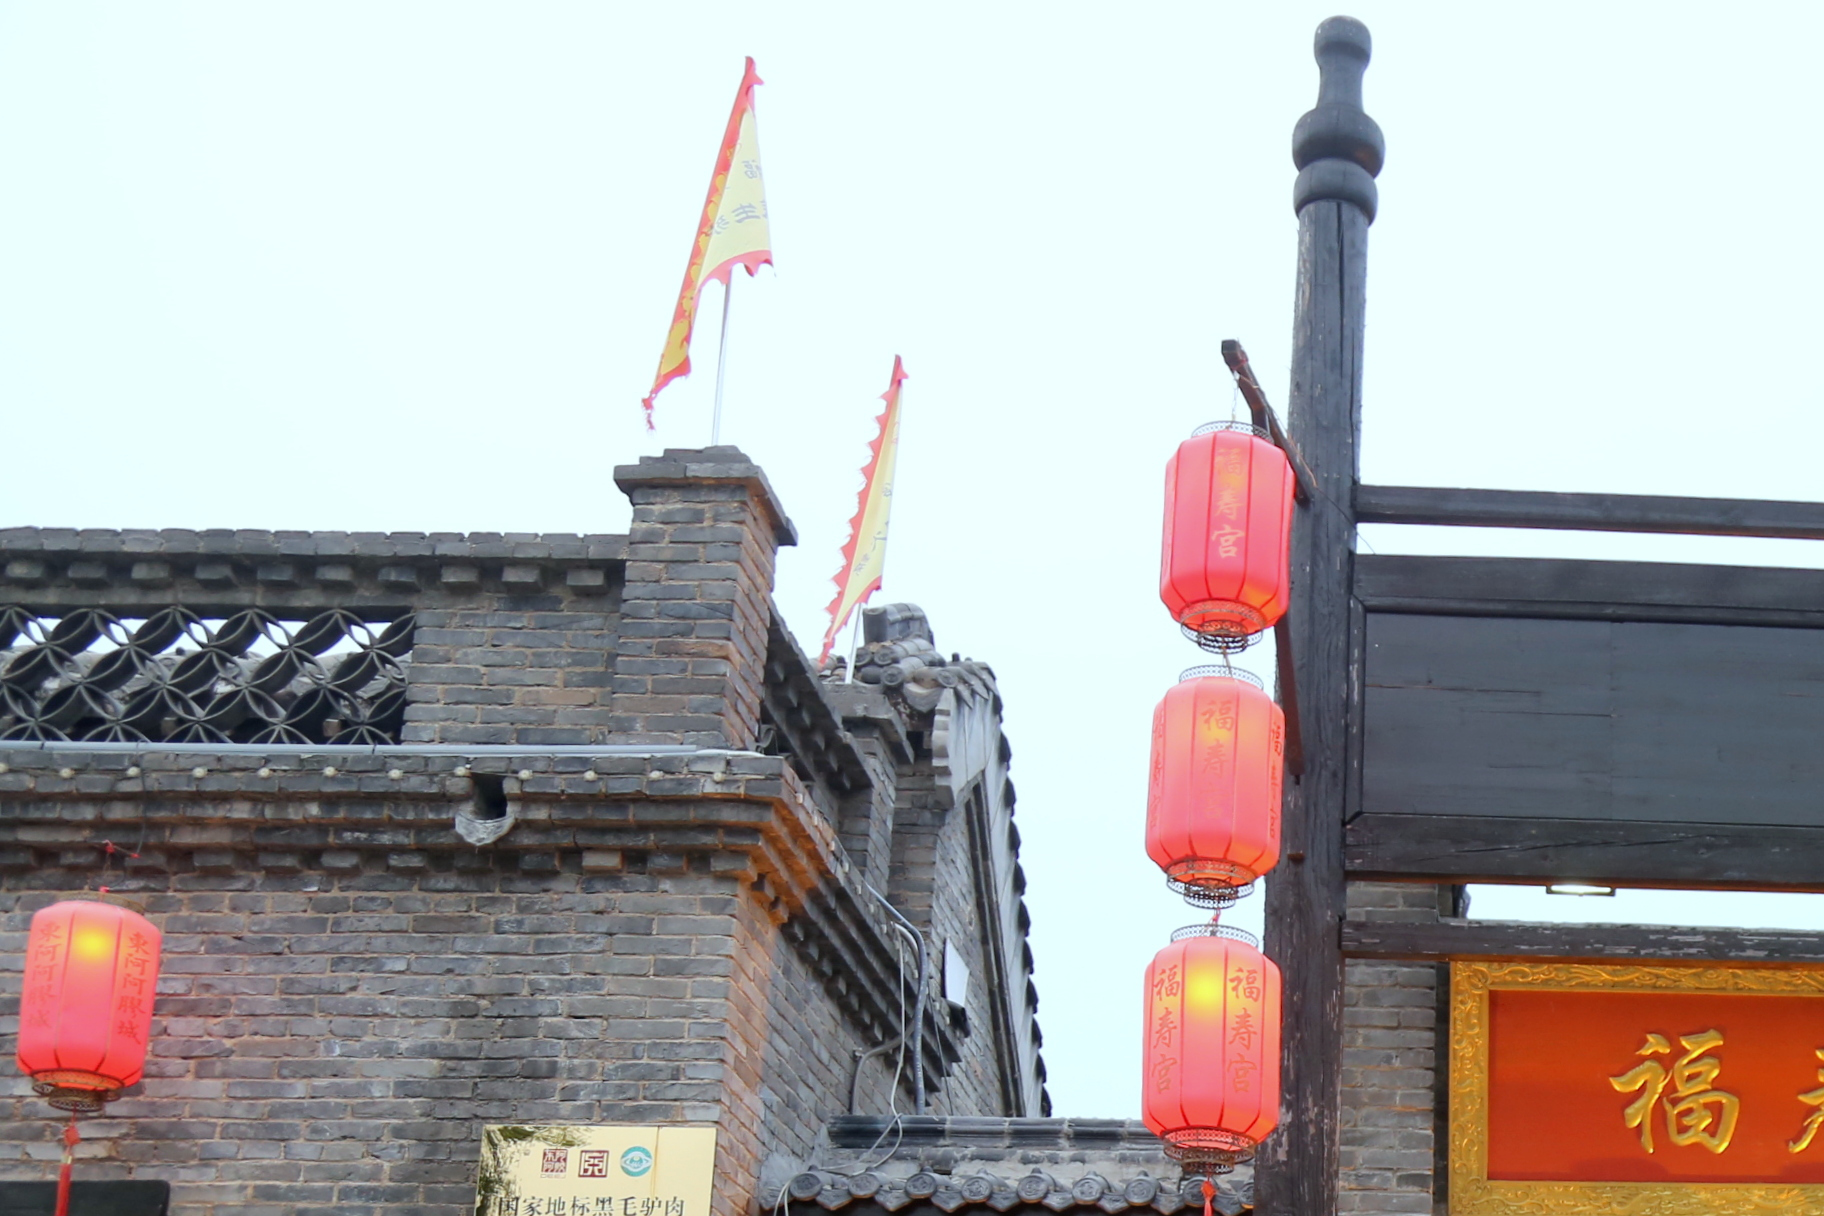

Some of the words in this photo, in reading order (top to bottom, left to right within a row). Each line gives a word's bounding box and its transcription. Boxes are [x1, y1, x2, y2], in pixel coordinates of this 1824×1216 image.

[1151, 964, 1181, 1094] 福寿宫
[1227, 966, 1262, 1093] 福寿宫
